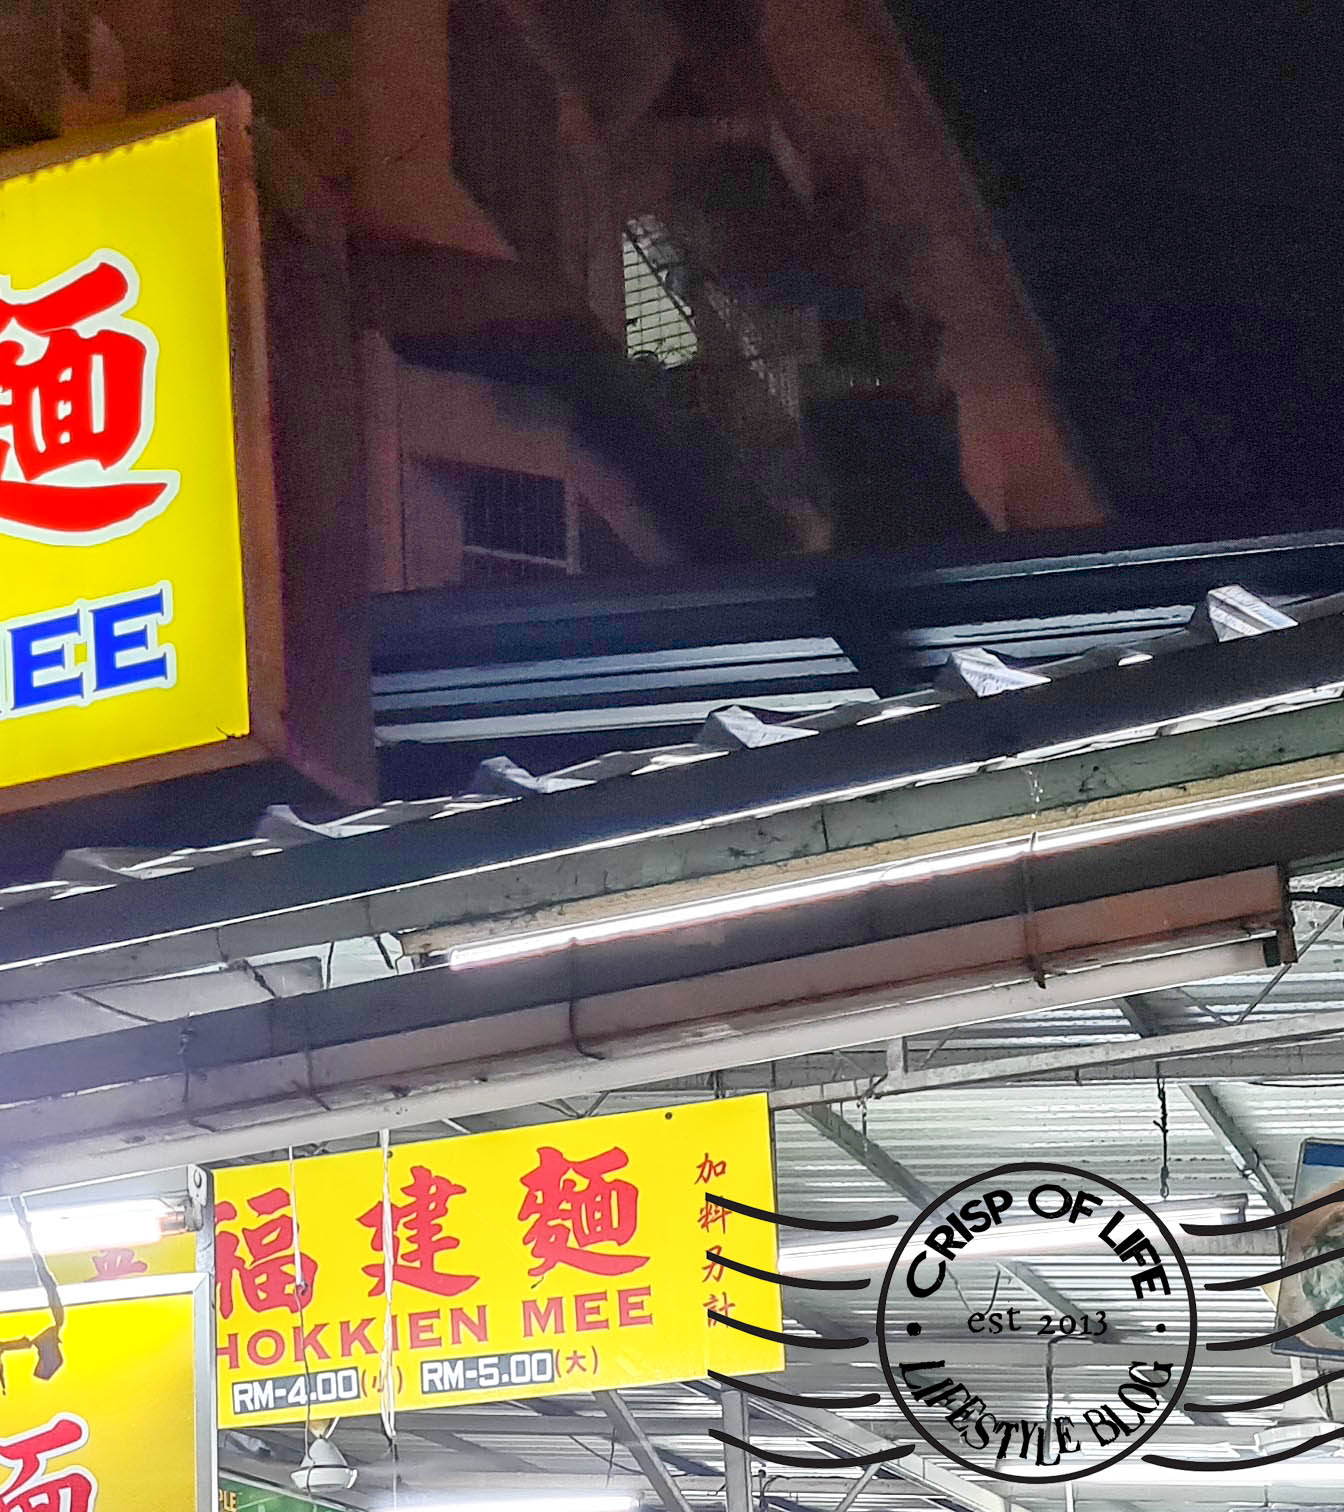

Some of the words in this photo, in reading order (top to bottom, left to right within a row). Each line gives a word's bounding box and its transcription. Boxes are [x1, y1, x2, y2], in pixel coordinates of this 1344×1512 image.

[522, 1286, 654, 1338] MEE
[234, 1370, 358, 1413] RM-4.00
[421, 1352, 553, 1393] RM-5.00
